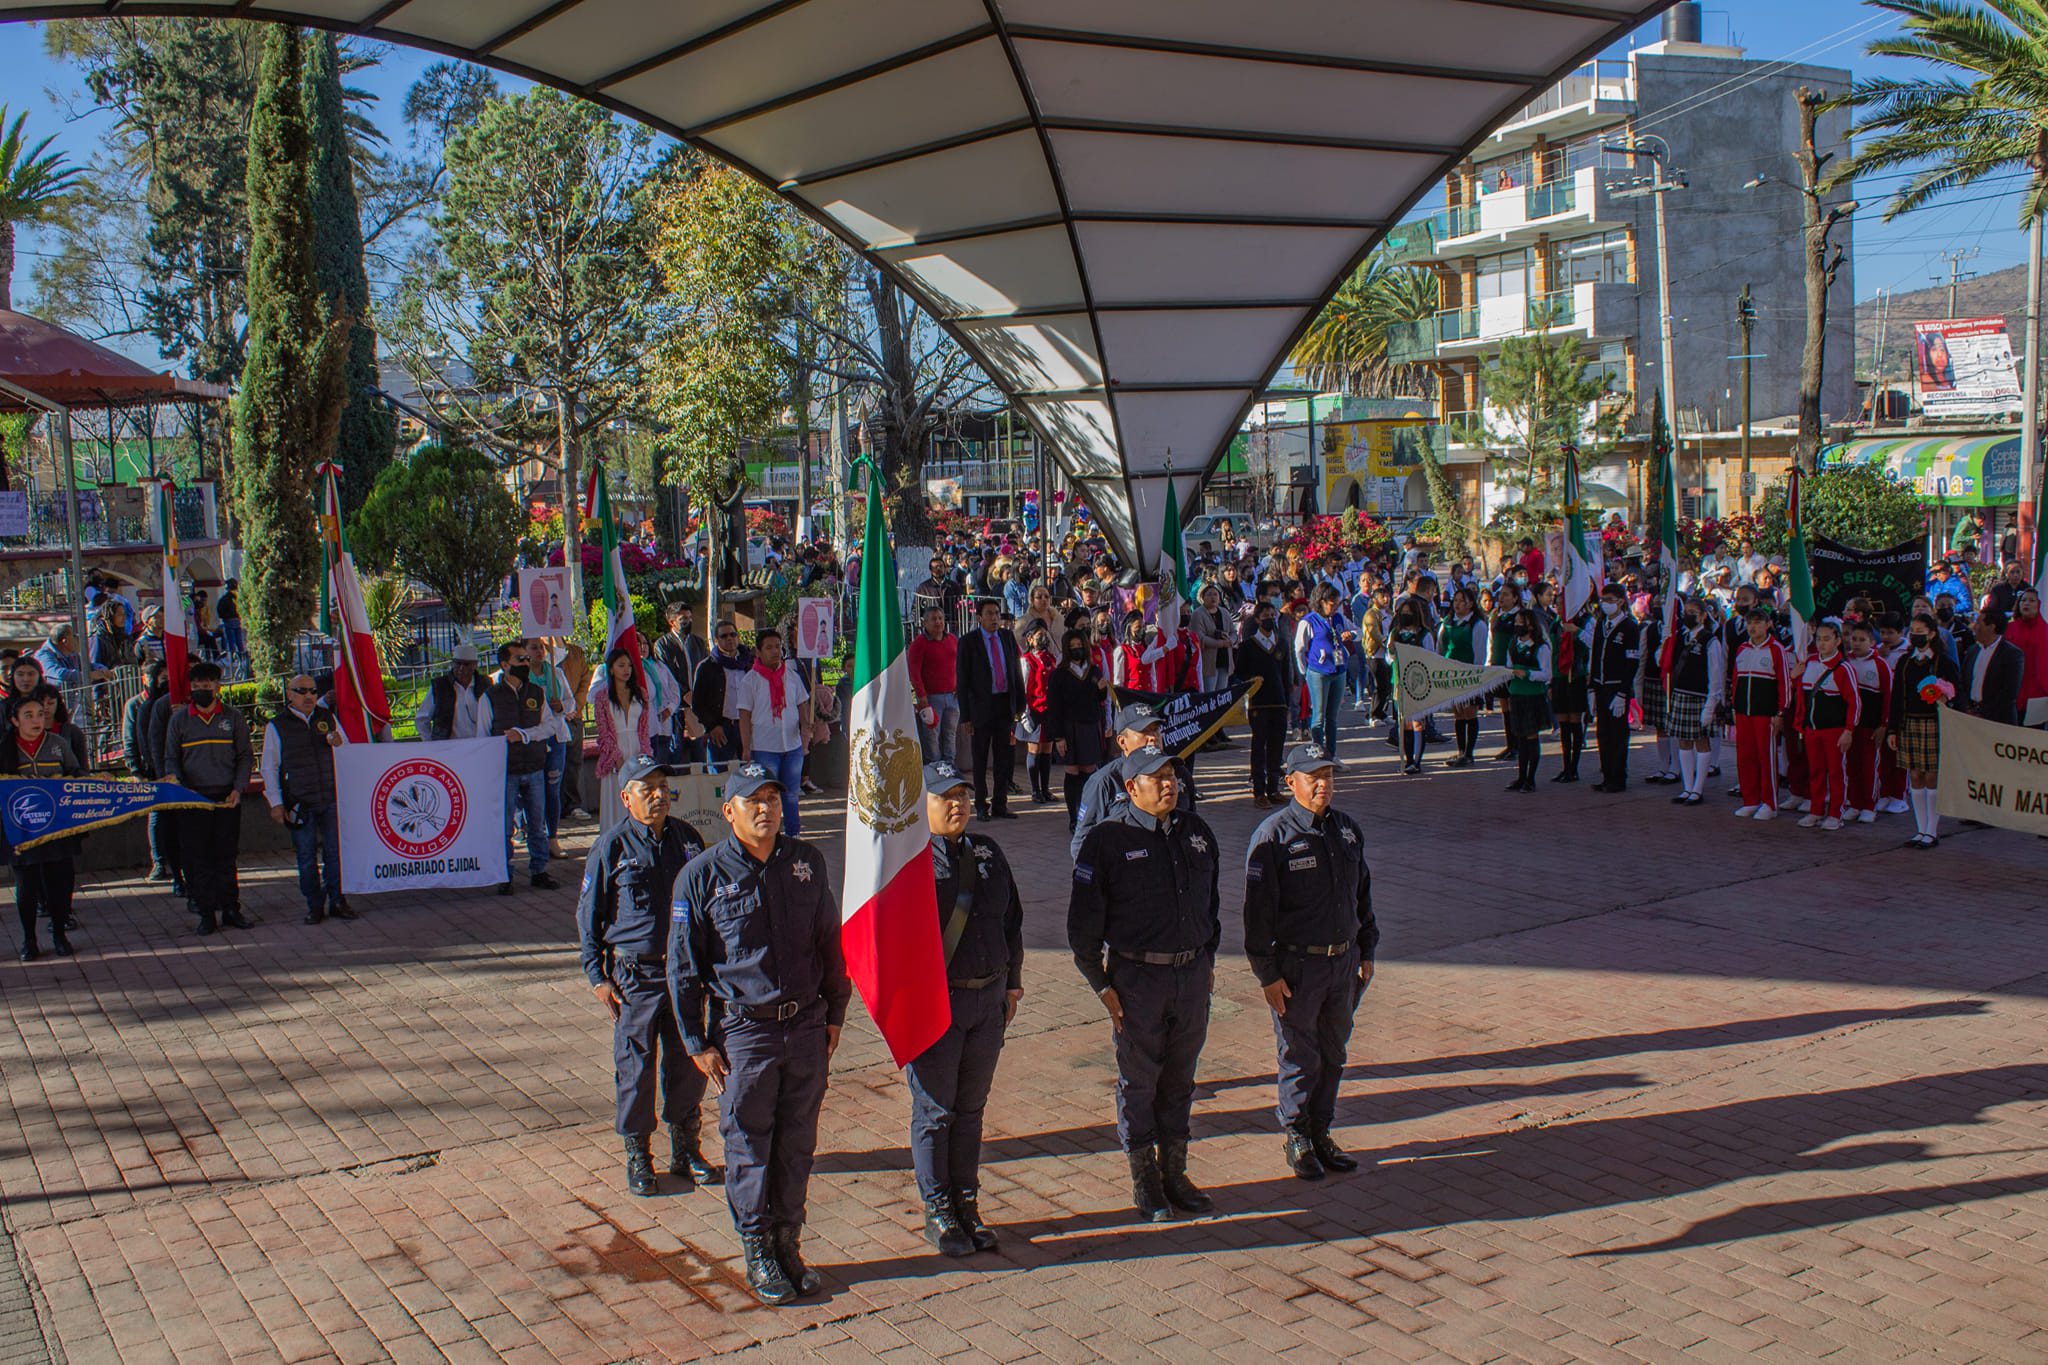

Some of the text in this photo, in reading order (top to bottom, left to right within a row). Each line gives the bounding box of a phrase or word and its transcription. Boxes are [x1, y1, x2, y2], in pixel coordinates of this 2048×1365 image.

[1926, 390, 1966, 399] RECOMPENSA
[1815, 548, 1844, 561] GOBIERNO
[1887, 555, 1896, 563] DE
[1843, 570, 1878, 584] SEC.
[1164, 692, 1191, 716] CBT
[1210, 698, 1216, 711] de
[1217, 691, 1232, 706] Garay
[1163, 720, 1202, 746] Tequixquiac
[378, 764, 461, 836] CAMPESINOS DE AMERICA
[1968, 779, 2003, 808] SAN
[375, 857, 480, 879] COMISARIADO EJIDAL
